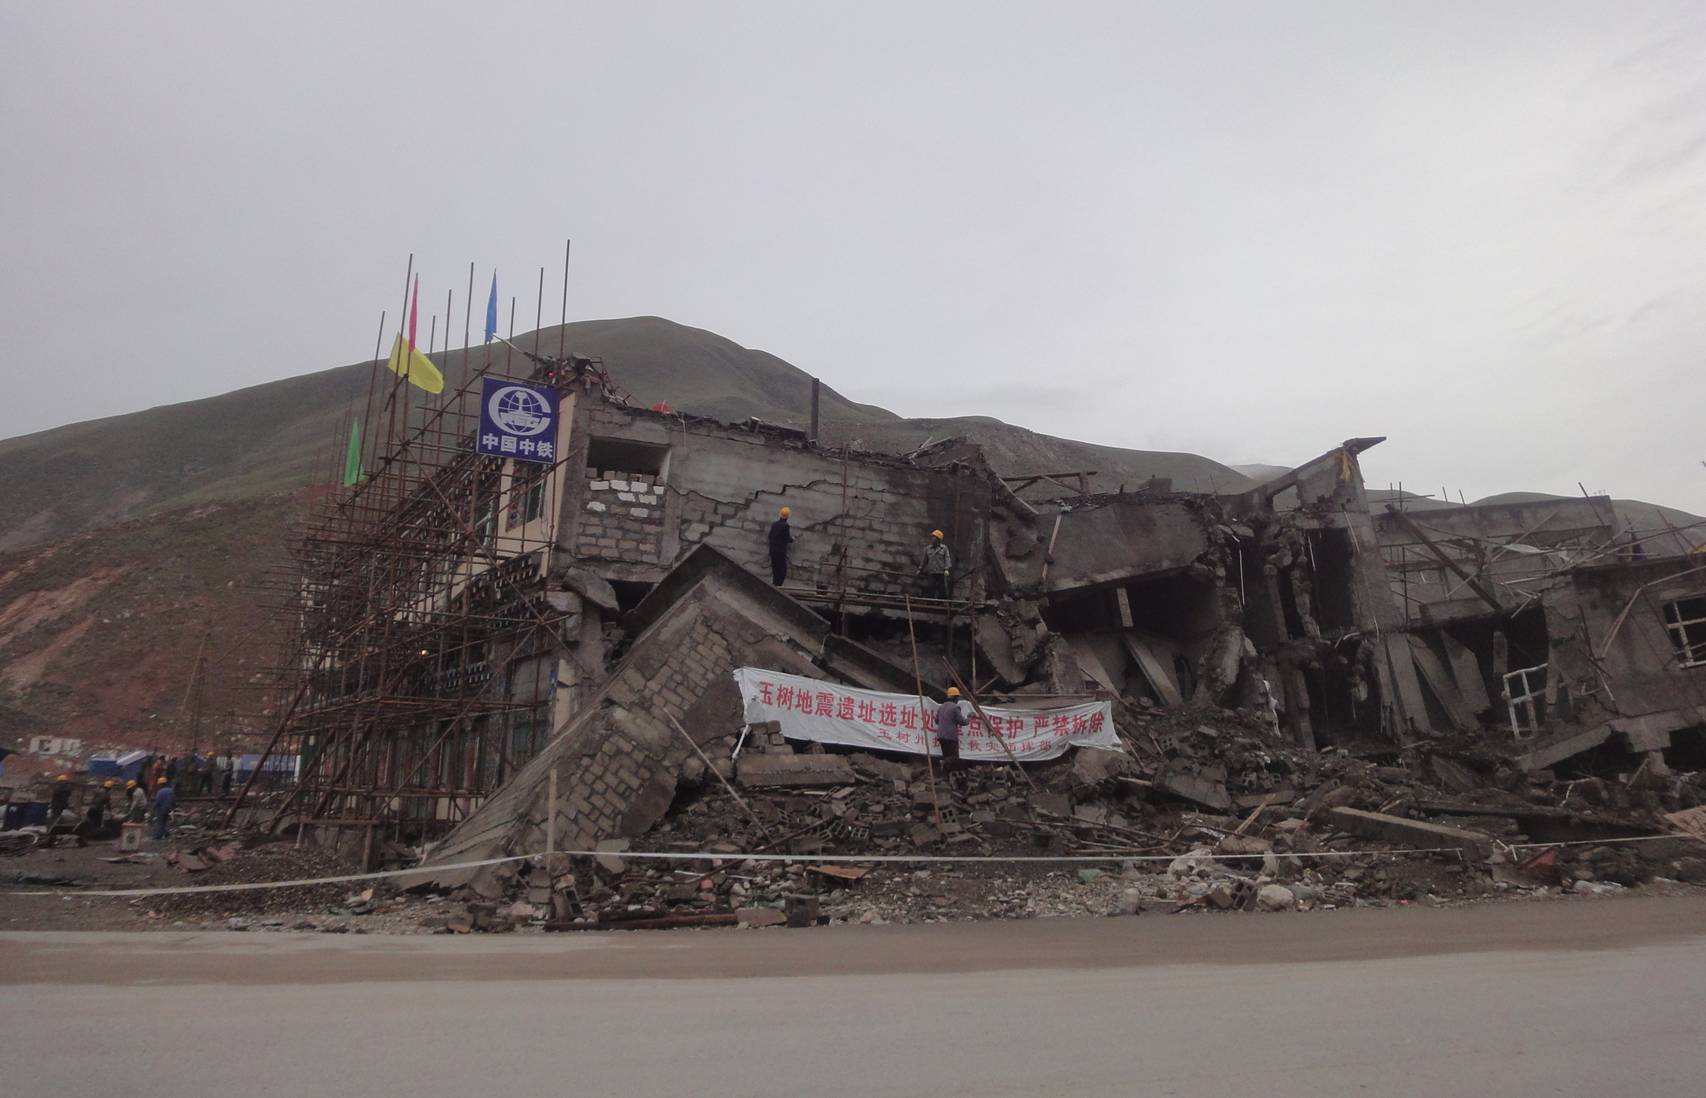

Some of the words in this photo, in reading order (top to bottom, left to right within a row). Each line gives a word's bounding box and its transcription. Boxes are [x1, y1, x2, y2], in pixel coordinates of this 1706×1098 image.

[482, 433, 553, 458] 中国中铁
[759, 681, 1024, 739] 玉树地震遗址选址处点保护
